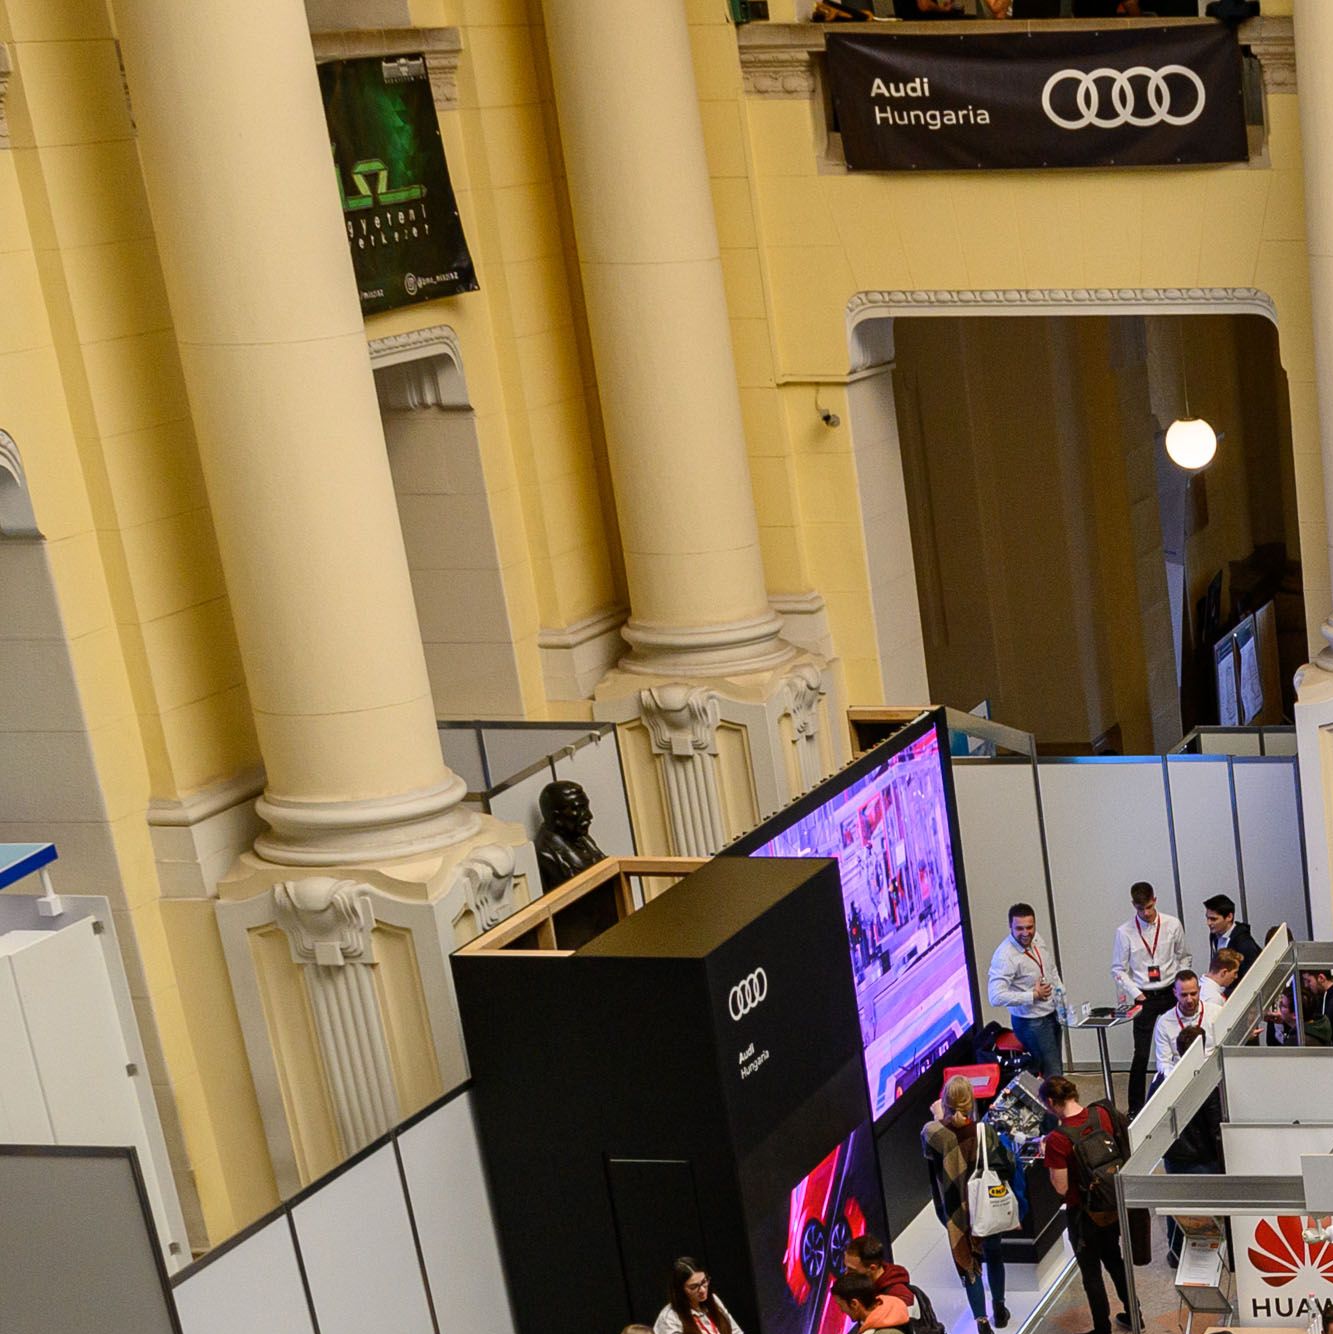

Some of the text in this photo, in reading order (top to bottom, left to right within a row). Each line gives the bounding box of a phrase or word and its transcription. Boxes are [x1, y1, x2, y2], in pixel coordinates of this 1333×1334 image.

[870, 77, 930, 98] Audi
[874, 105, 990, 129] Hungaria
[739, 1042, 755, 1065] Audi
[741, 1050, 770, 1080] Hungaria
